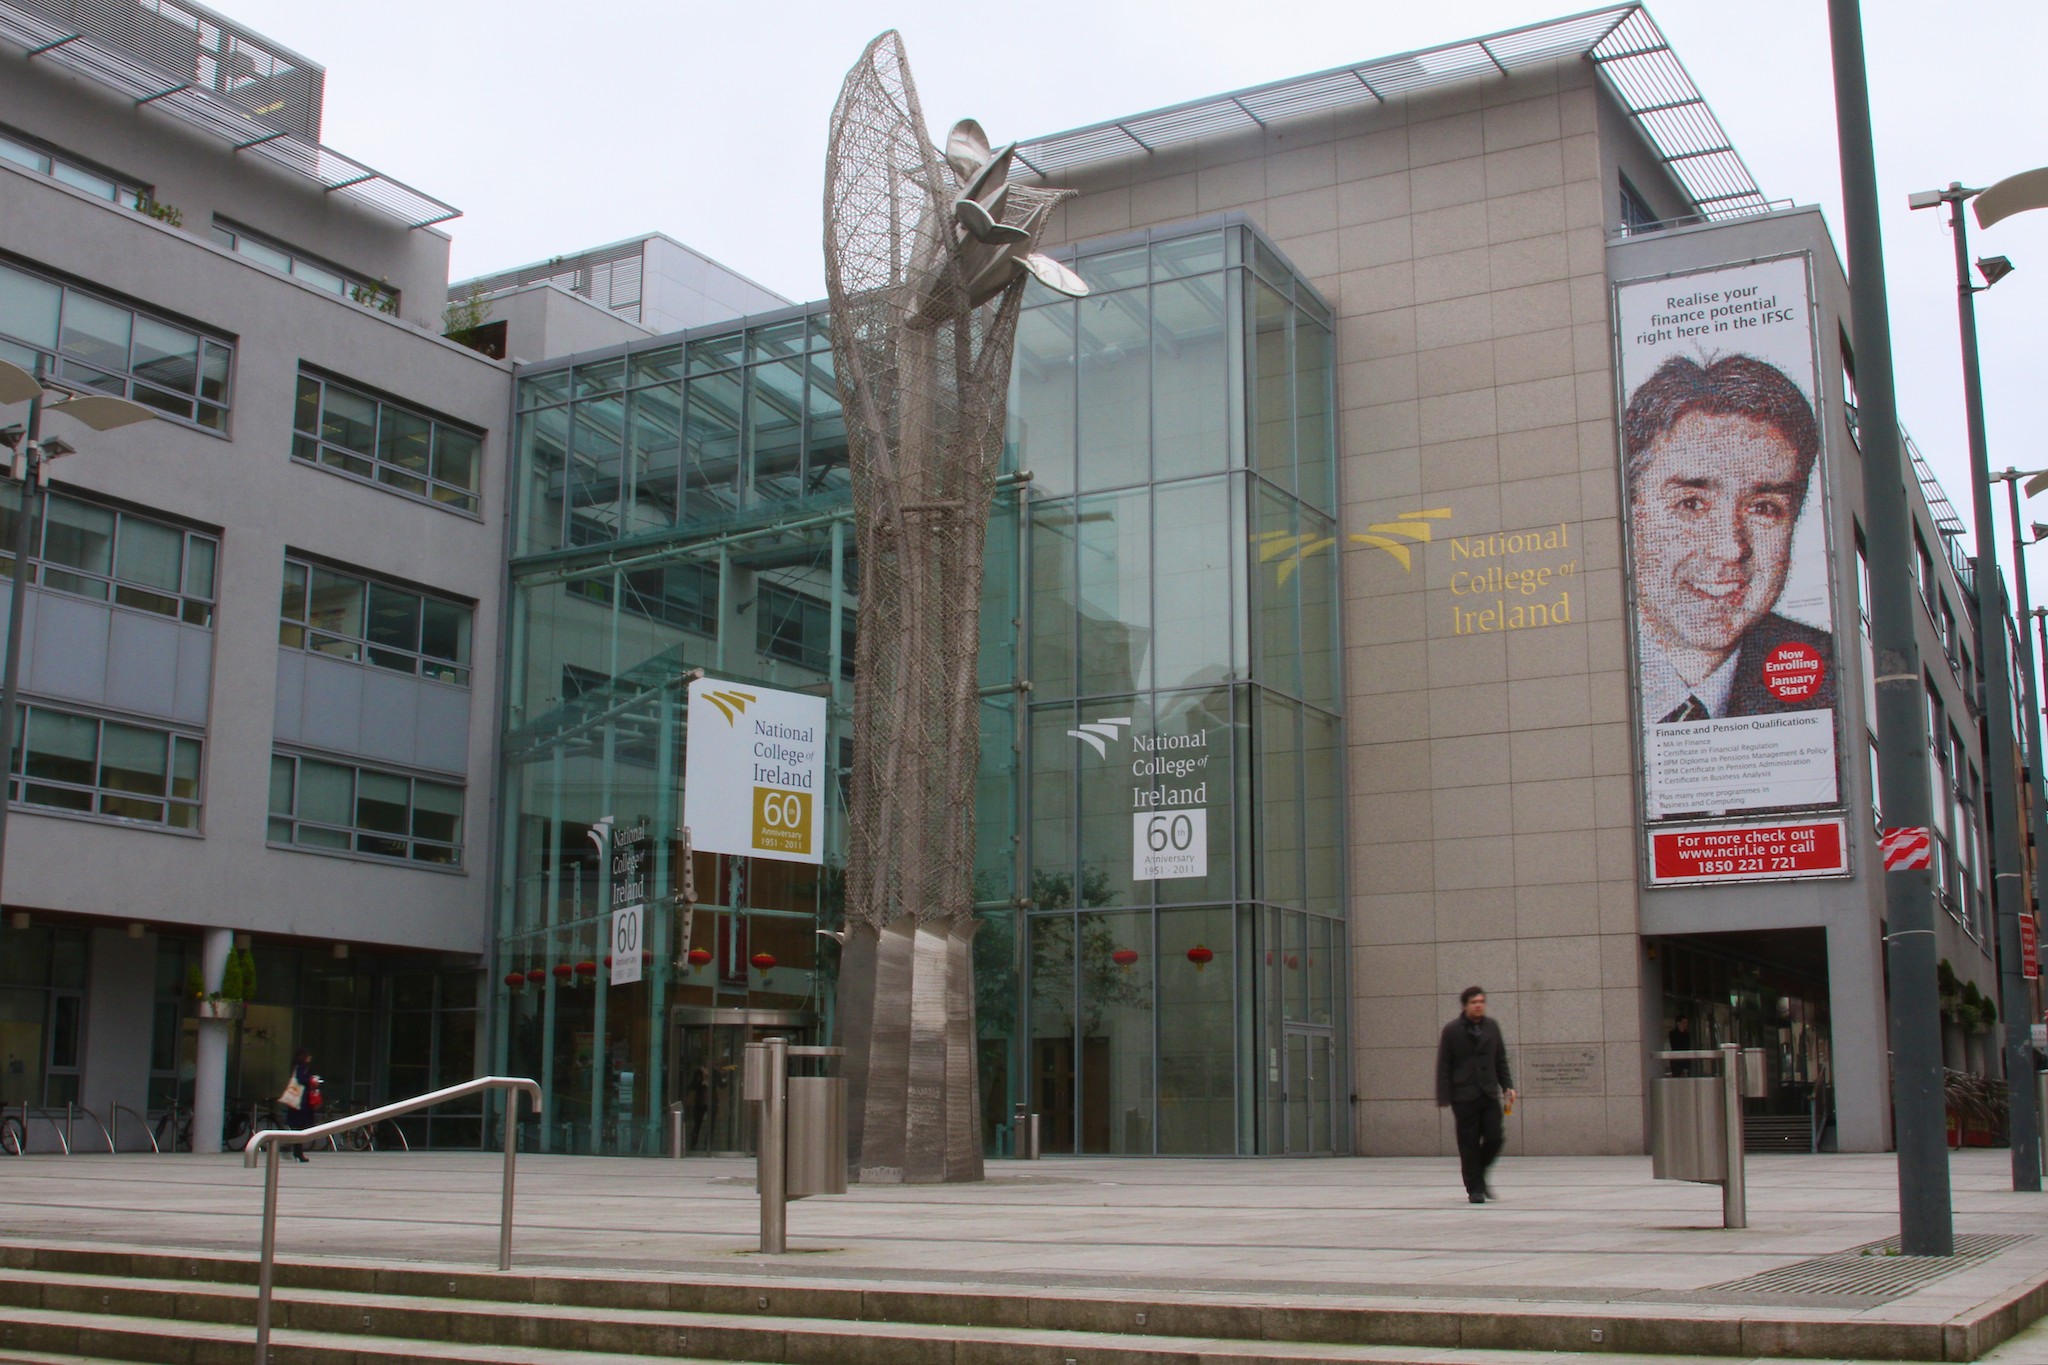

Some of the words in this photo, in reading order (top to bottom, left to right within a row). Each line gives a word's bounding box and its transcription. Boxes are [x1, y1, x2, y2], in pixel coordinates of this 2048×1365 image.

[1666, 292, 1719, 309] Realise
[1724, 285, 1758, 302] your
[1651, 309, 1705, 327] finance
[1710, 296, 1777, 320] potential
[1636, 328, 1672, 345] right
[1677, 321, 1709, 338] here
[1715, 321, 1728, 332] in
[1733, 315, 1757, 330] the
[1762, 308, 1795, 325] IFSC
[1450, 522, 1569, 561] National
[1451, 567, 1551, 595] College
[1559, 559, 1577, 578] of
[1453, 592, 1571, 635] Ireland
[1766, 659, 1818, 672] Enrolling
[1778, 650, 1804, 660] Now
[1770, 674, 1816, 688] January
[1779, 685, 1808, 696] Start
[755, 720, 813, 743] National
[1656, 728, 1691, 737] Finance
[1693, 726, 1710, 734] and
[1713, 723, 1749, 732] Pension
[1752, 717, 1819, 730] Qualifications:
[1133, 728, 1207, 752] National
[1663, 749, 1698, 757] Certificate
[1709, 744, 1739, 753] Financial
[1741, 742, 1779, 751] Regulation
[754, 742, 804, 766] College
[806, 751, 816, 762] of
[1680, 757, 1709, 766] Diploma
[1719, 754, 1750, 762] Pensions
[1752, 749, 1797, 759] Management
[1806, 747, 1828, 755] Policy
[753, 763, 813, 789] Ireland
[1132, 757, 1196, 778] College
[1197, 754, 1209, 768] of
[1680, 766, 1716, 774] Certificate
[1726, 762, 1756, 770] Pensions
[1758, 758, 1811, 768] Administration
[1664, 776, 1700, 784] Certificate
[1710, 772, 1740, 780] Business
[1742, 770, 1771, 778] Analysis
[1133, 782, 1207, 808] Ireland
[1659, 801, 1689, 809] Business
[1706, 796, 1745, 806] Computing
[1675, 792, 1694, 800] many
[1716, 786, 1760, 797] programmes
[764, 792, 801, 828] 60
[614, 820, 645, 848] National
[762, 828, 802, 840] Anniversary
[1146, 814, 1193, 852] 60
[1677, 835, 1700, 847] For
[1704, 834, 1741, 846] more
[1745, 829, 1786, 843] check
[1790, 828, 1815, 840] out
[761, 838, 778, 848] 1951
[785, 840, 802, 850] 2011
[1678, 846, 1766, 860] www.ncirl.ie
[1770, 844, 1785, 854] or
[1789, 840, 1815, 853] call
[613, 853, 639, 875] College
[1144, 854, 1195, 865] Anniversary
[1144, 865, 1164, 875] 1951
[1173, 864, 1195, 874] 2011
[1698, 859, 1733, 873] 1850
[1738, 858, 1764, 870] 221
[1771, 856, 1796, 869] 721
[613, 874, 644, 904] Ireland
[618, 911, 637, 953] 60
